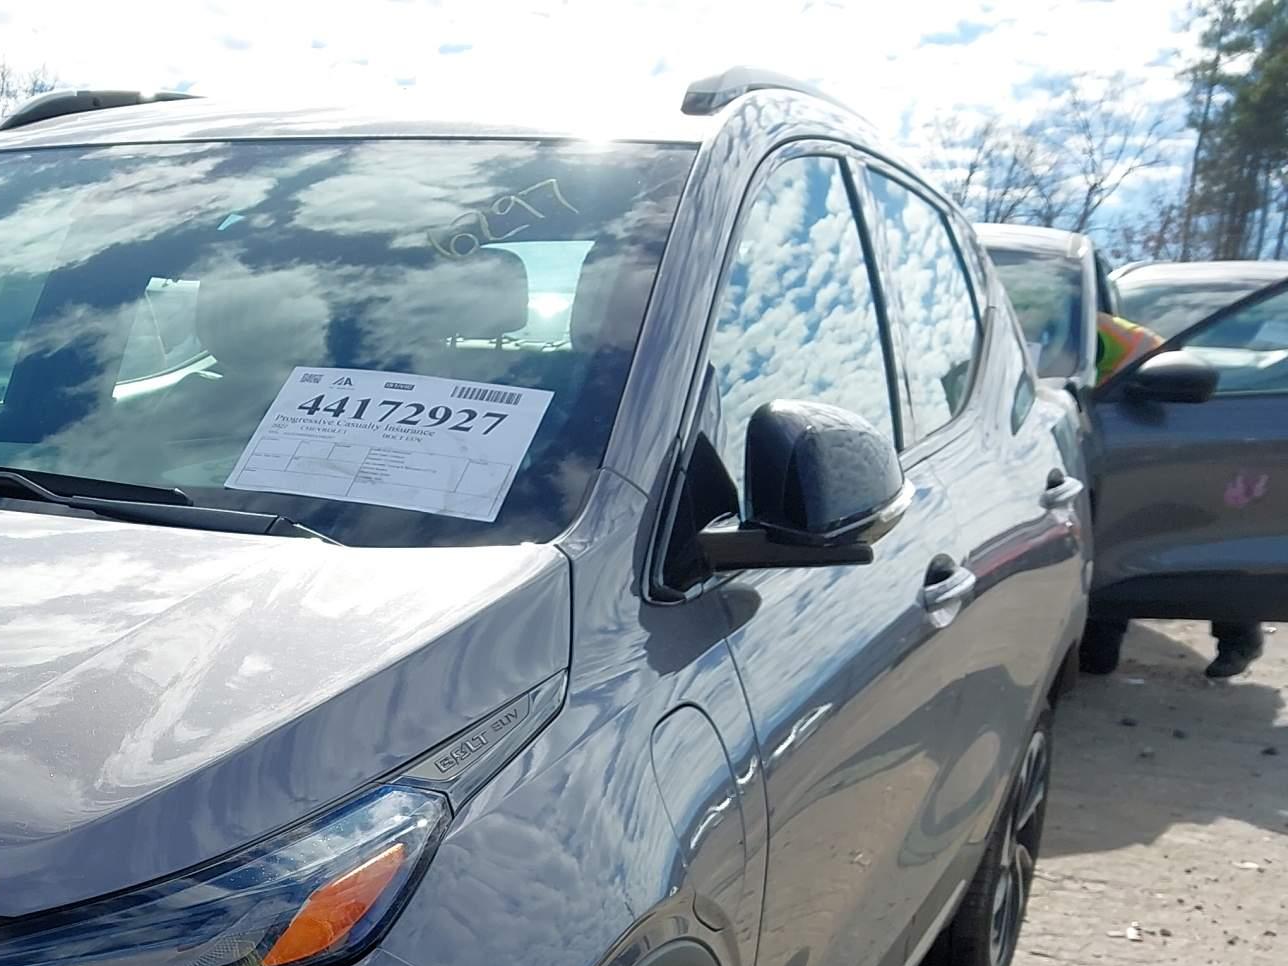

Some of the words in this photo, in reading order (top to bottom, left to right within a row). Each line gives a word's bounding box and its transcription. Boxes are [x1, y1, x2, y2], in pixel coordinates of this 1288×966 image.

[275, 414, 333, 426] Progressive
[336, 420, 380, 432] Casualty
[384, 424, 436, 437] Insurance
[297, 394, 509, 436] 44172927
[490, 709, 519, 733] EUV
